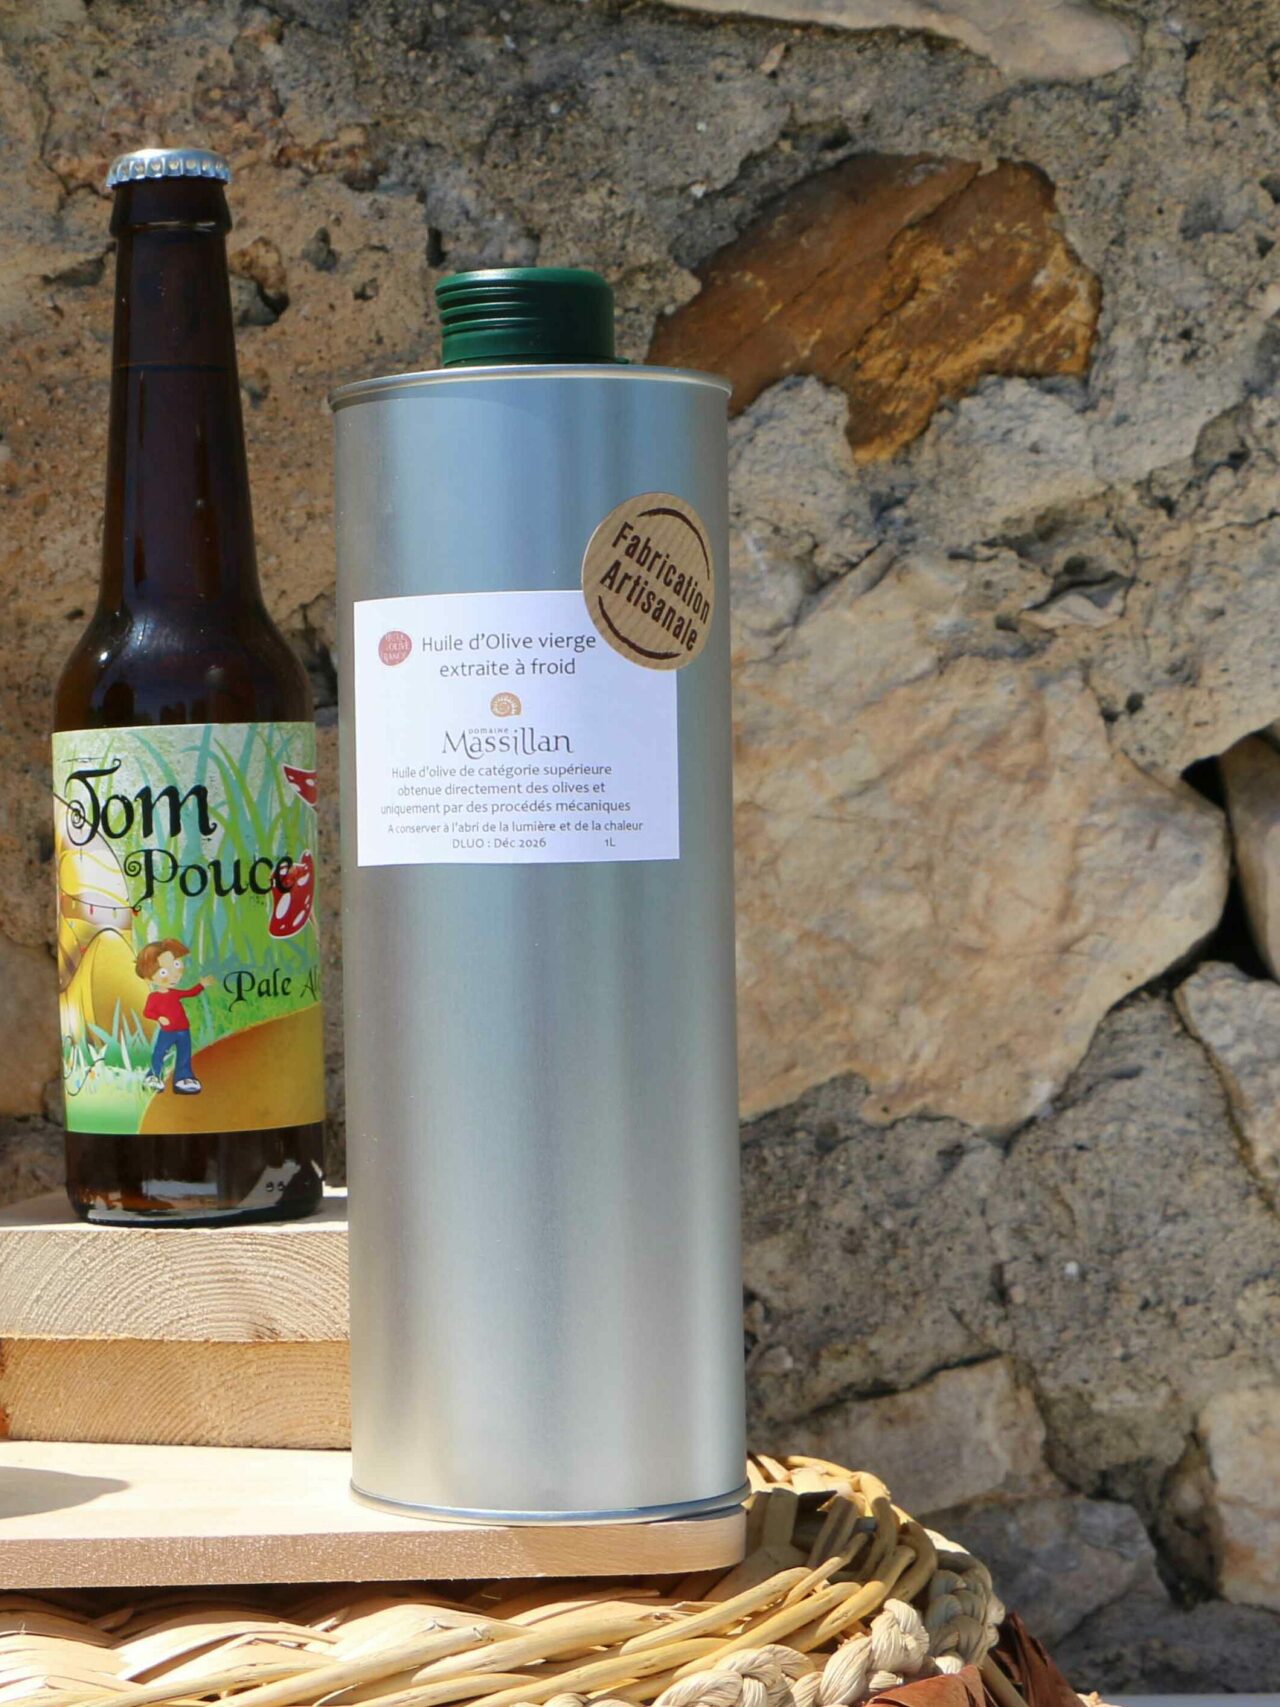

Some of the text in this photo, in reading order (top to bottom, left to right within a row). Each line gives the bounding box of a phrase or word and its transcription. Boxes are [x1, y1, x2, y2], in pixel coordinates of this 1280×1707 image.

[611, 521, 710, 624] Fabrication
[599, 559, 698, 652] Artisanale
[422, 634, 463, 653] Huile
[469, 632, 533, 651] d'Olive
[538, 631, 597, 653] vierge
[440, 658, 576, 678] extraite à froid
[442, 727, 575, 760] Massillan
[391, 763, 612, 779] Huile d'olive de catégorie supérieure
[398, 782, 605, 797] obtenue directement des olives et
[65, 758, 218, 846] Tom
[380, 799, 631, 816] uniquement par des procédés mécaniques
[388, 820, 644, 834] A conserver à l'abri de la lumière et de la chaleur
[452, 838, 484, 849] DLUO
[494, 838, 516, 848] Déc
[519, 837, 547, 848] 2026
[604, 837, 616, 847] 1L
[124, 847, 294, 912] Pouce
[224, 968, 292, 1012] Pale
